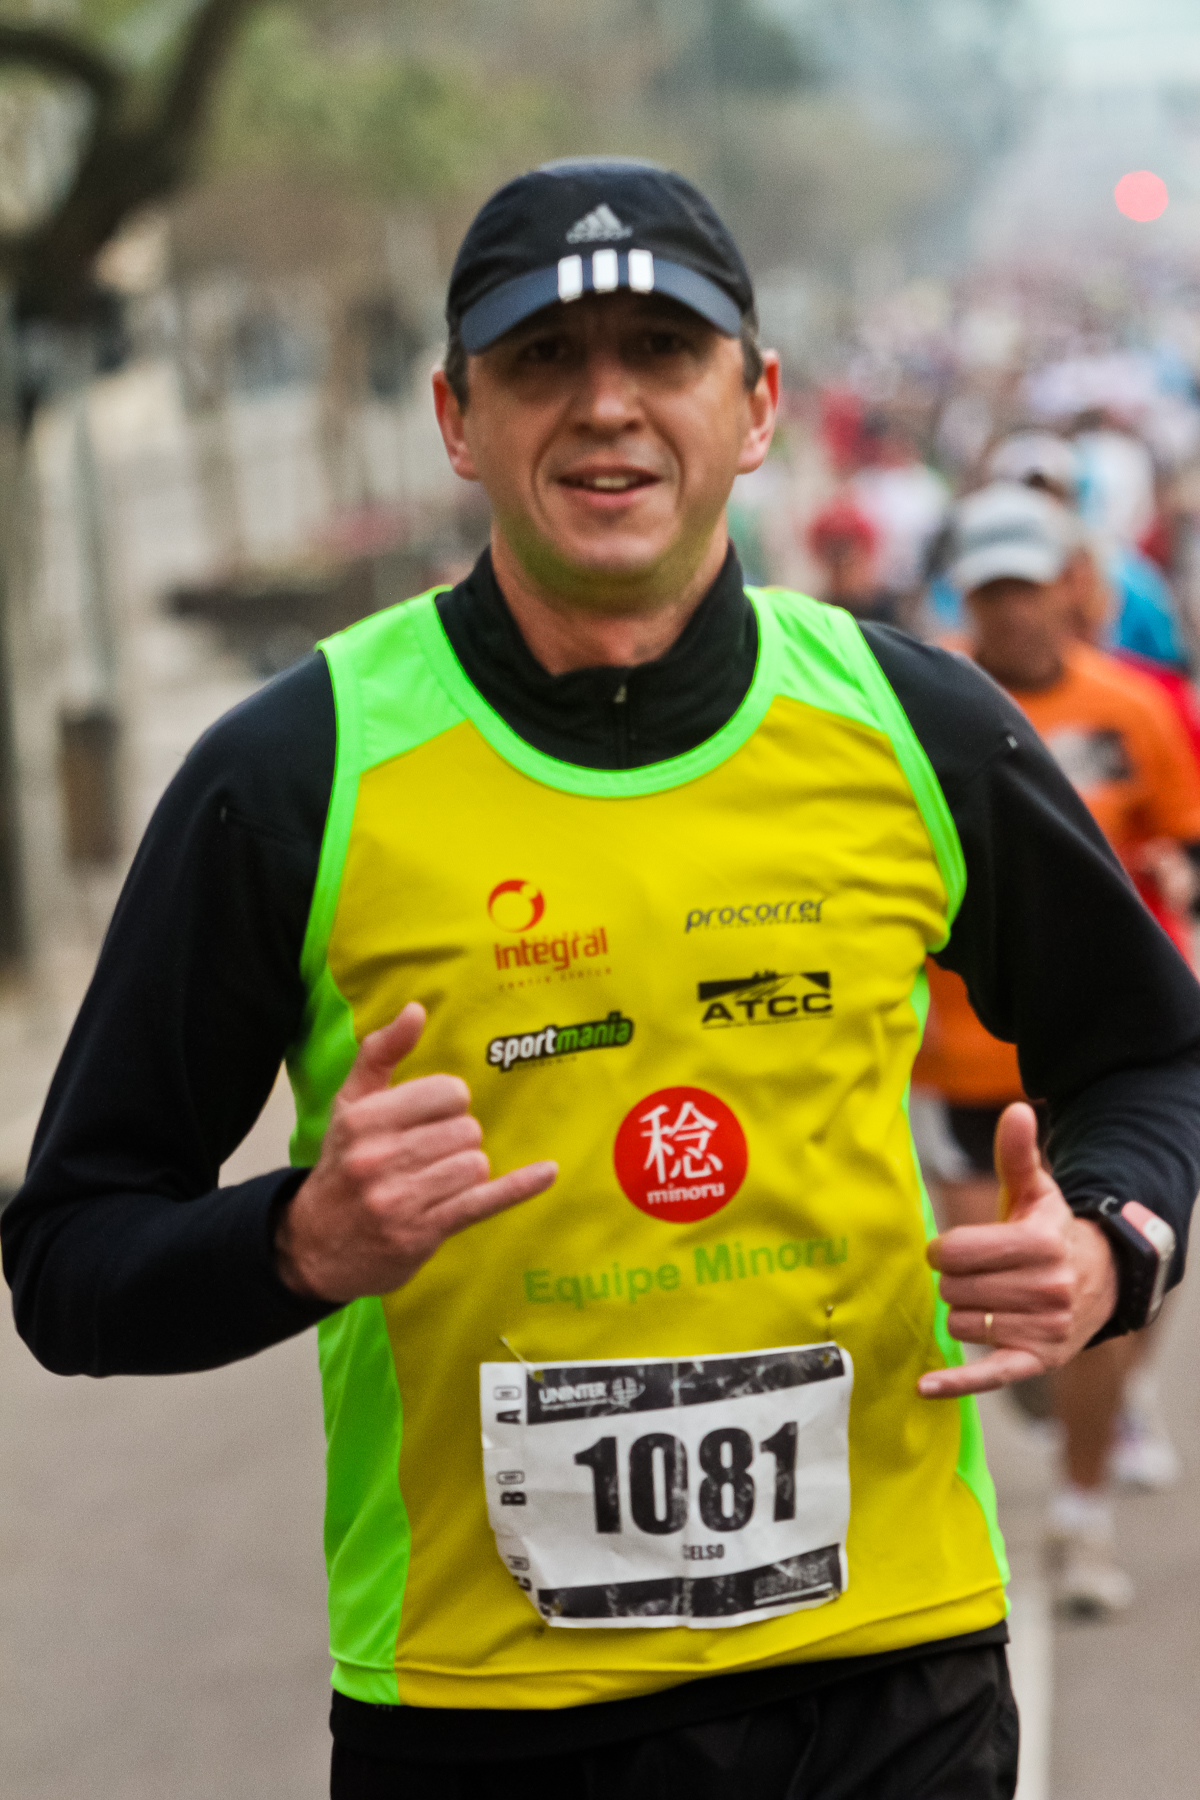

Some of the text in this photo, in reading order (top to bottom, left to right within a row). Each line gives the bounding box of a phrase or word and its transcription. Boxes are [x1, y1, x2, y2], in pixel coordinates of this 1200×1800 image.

[684, 900, 823, 933] procorrer
[702, 992, 833, 1023] ATCC
[490, 1013, 631, 1068] sportmania
[647, 1182, 726, 1206] minoru
[523, 1237, 849, 1310] Equipe Minoru
[574, 1421, 799, 1536] 1081
